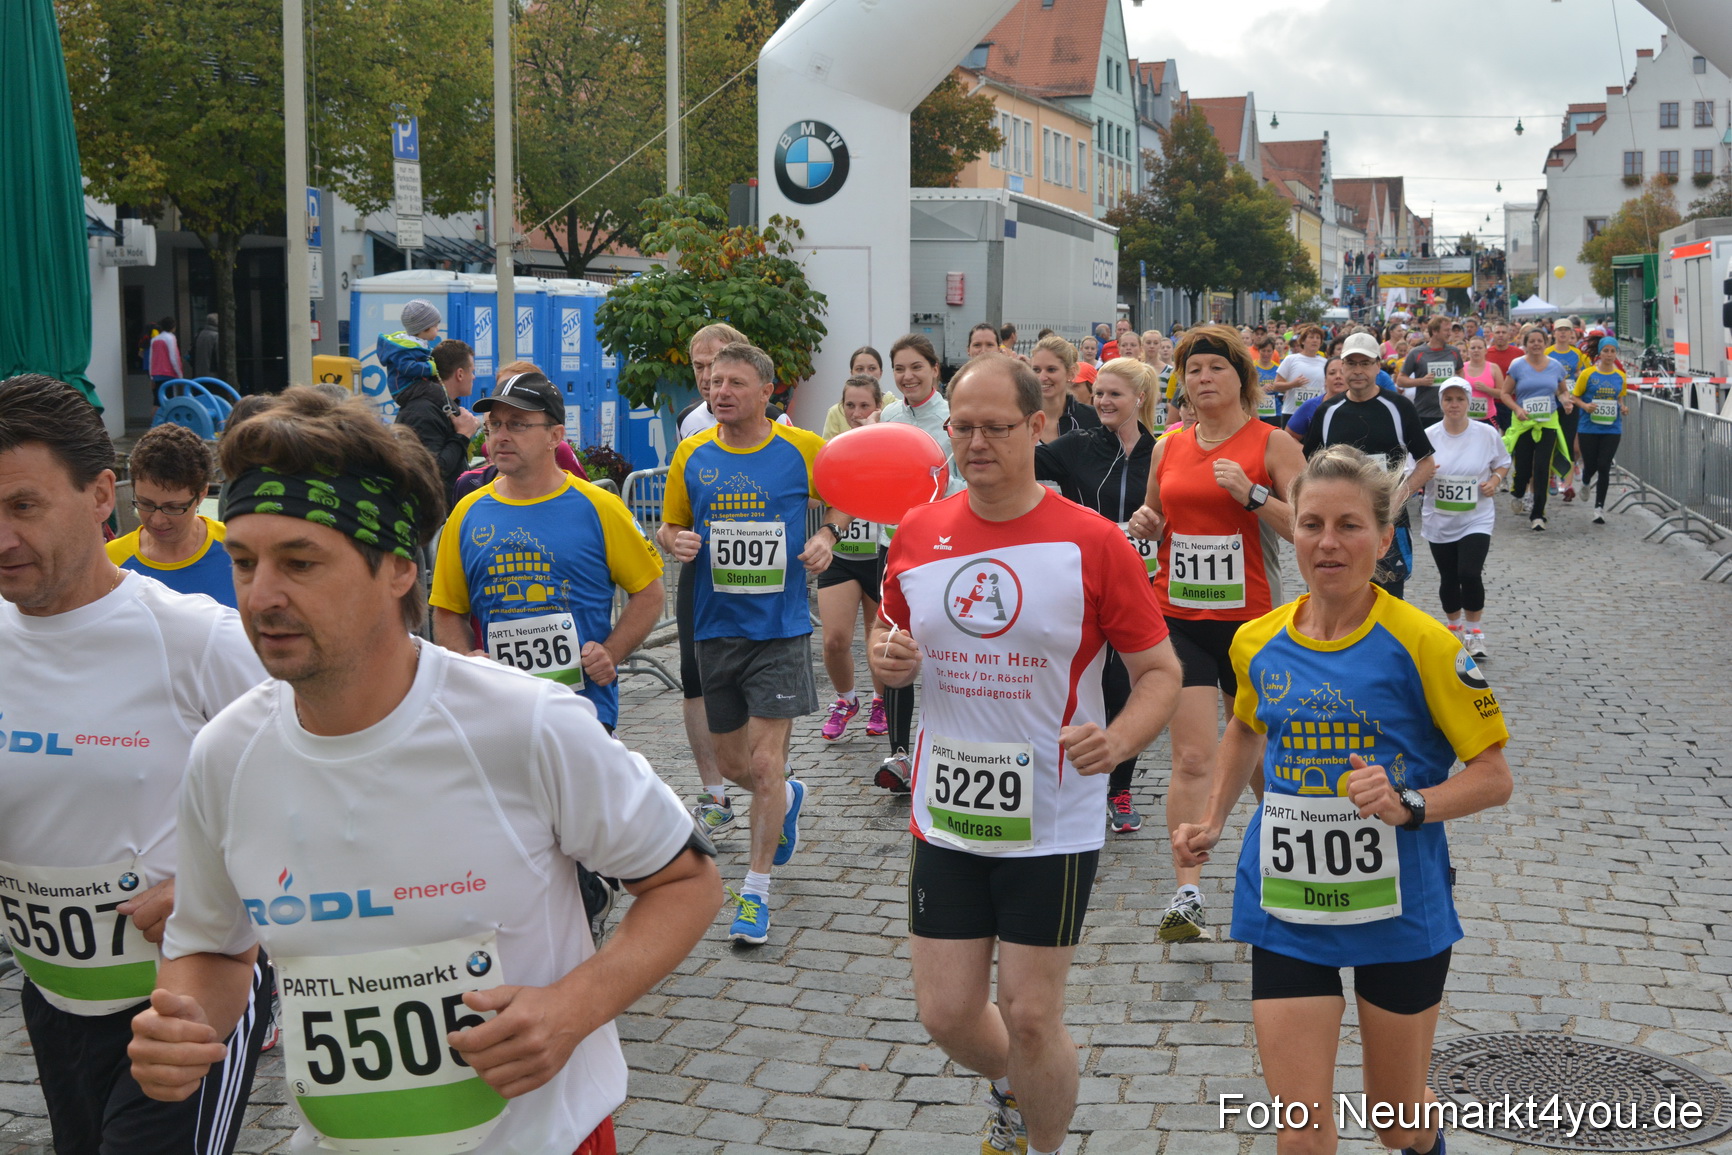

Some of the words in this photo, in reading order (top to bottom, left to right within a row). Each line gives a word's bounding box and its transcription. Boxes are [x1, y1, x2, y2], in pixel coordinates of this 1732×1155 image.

[780, 122, 844, 150] BMW
[341, 271, 350, 290] 3
[1408, 276, 1441, 285] START
[1526, 402, 1549, 413] 5027
[1437, 484, 1472, 501] 5521
[711, 528, 736, 537] PARTL
[736, 529, 774, 538] Neumarkt
[717, 539, 779, 567] 5097
[840, 543, 860, 553] Sonja
[933, 543, 953, 551] erima
[1172, 540, 1190, 549] PARTL
[1191, 542, 1229, 551] Neumarkt
[1174, 552, 1234, 581] 5111
[726, 572, 767, 587] Stephan
[1182, 587, 1226, 599] Annelies
[488, 629, 515, 640] PARTL
[515, 624, 559, 637] Neumarkt
[496, 634, 572, 672] 5536
[936, 667, 946, 678] Dr.
[947, 669, 970, 681] Heck
[972, 670, 978, 682] /
[980, 672, 995, 682] Dr.
[997, 672, 1034, 684] Röschl
[1270, 673, 1281, 681] 15
[1265, 682, 1285, 692] Jahre
[74, 730, 151, 749] energie
[932, 744, 956, 761] PARTL
[957, 751, 1012, 766] Neumarkt
[1284, 754, 1348, 766] 21.September
[935, 763, 1022, 813] 5229
[1264, 804, 1299, 822] PARTL
[1300, 809, 1364, 823] Neumark
[947, 815, 1004, 838] Andreas
[1271, 826, 1384, 877] 5103
[0, 874, 26, 893] RTL
[28, 880, 112, 898] Neumarkt
[393, 870, 488, 901] energie
[1303, 887, 1351, 908] Doris
[0, 894, 129, 961] 5507
[282, 977, 345, 998] PARTL
[347, 963, 460, 996] Neumarkt
[296, 1081, 306, 1095] S
